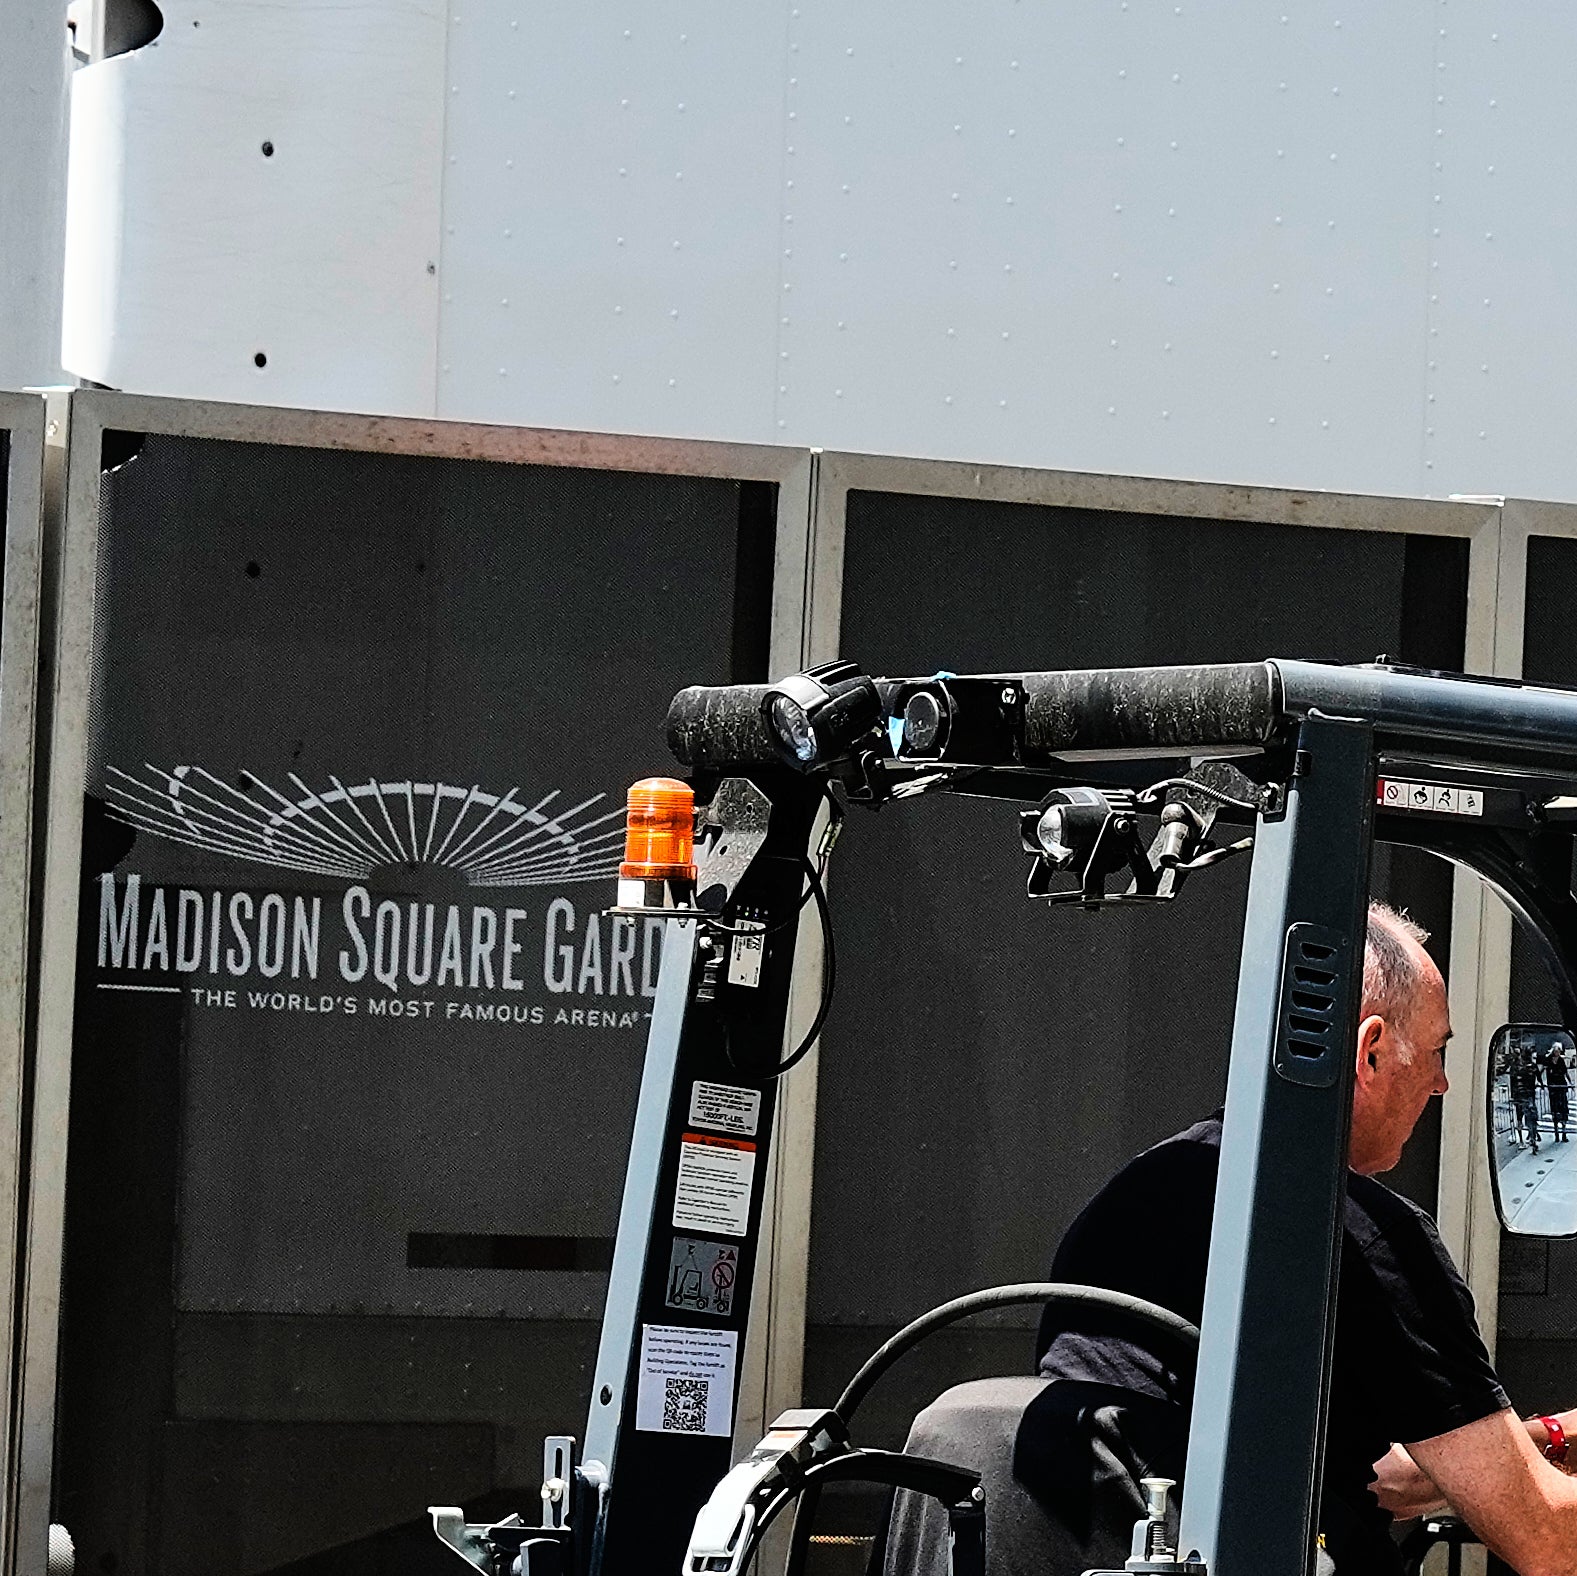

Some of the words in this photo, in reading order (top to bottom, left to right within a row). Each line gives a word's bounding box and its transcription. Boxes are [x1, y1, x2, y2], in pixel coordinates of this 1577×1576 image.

[97, 872, 320, 980] MADISON
[338, 885, 525, 993] SQUARE
[543, 897, 666, 998] GARD
[190, 987, 238, 1008] THE
[247, 991, 359, 1014] WORLD'S
[367, 998, 436, 1019] MOST
[445, 1002, 546, 1026] FAMOUS
